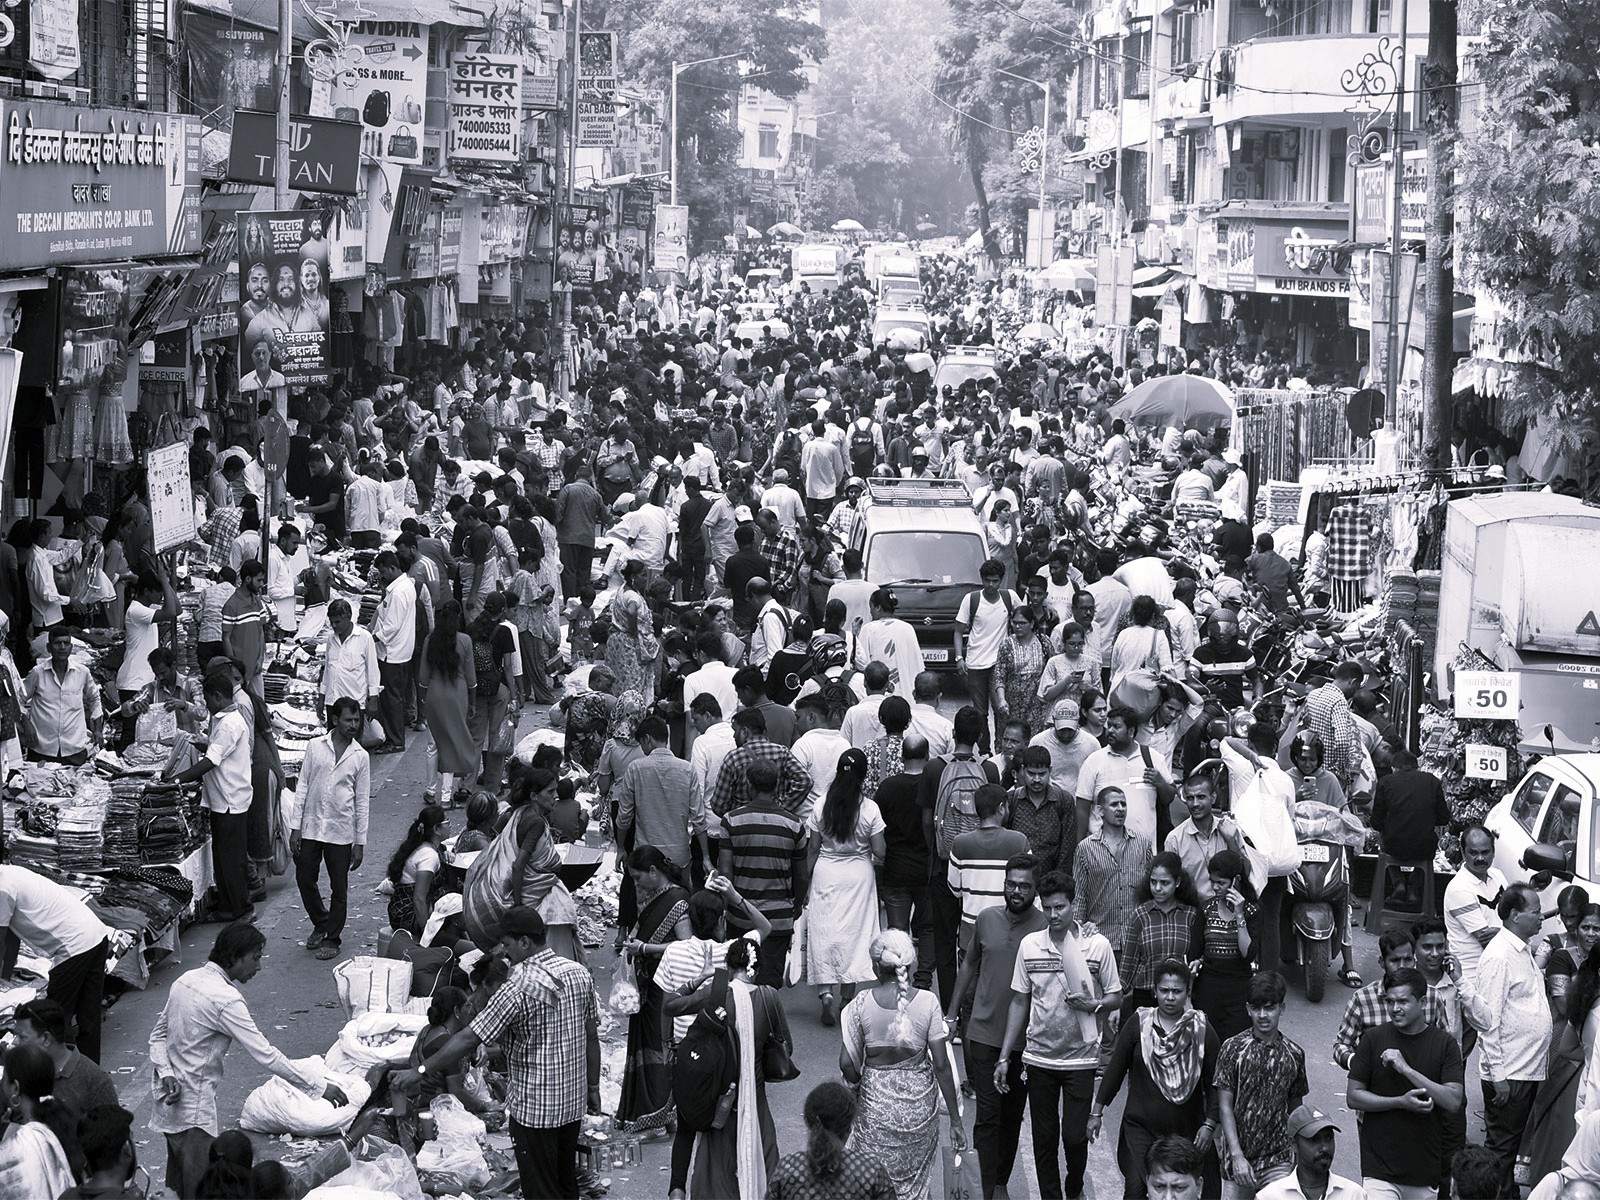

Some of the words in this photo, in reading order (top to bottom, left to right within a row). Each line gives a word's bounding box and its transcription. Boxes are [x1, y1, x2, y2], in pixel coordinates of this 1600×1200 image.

[225, 30, 265, 41] SUVIDHA
[453, 56, 518, 79] हॉटेल
[452, 79, 518, 101] मनहर
[488, 101, 518, 119] फ्लोर
[579, 103, 592, 114] SAI
[594, 103, 616, 114] BABA
[458, 120, 511, 135] 7400005333
[457, 137, 511, 151] 7400005444
[255, 155, 333, 184] TIAN
[17, 213, 32, 232] THE
[34, 212, 62, 232] DECCAN
[64, 210, 102, 230] MERCHANTS
[125, 209, 141, 227] BANK
[142, 208, 154, 226] LTD.
[269, 219, 304, 231] नवरात्र
[272, 231, 302, 242] उत्सव
[1297, 280, 1336, 293] BRANDS
[155, 370, 185, 380] CENTRE
[1558, 664, 1586, 673] GOODS
[1476, 689, 1508, 708] 50
[1480, 757, 1499, 772] 50
